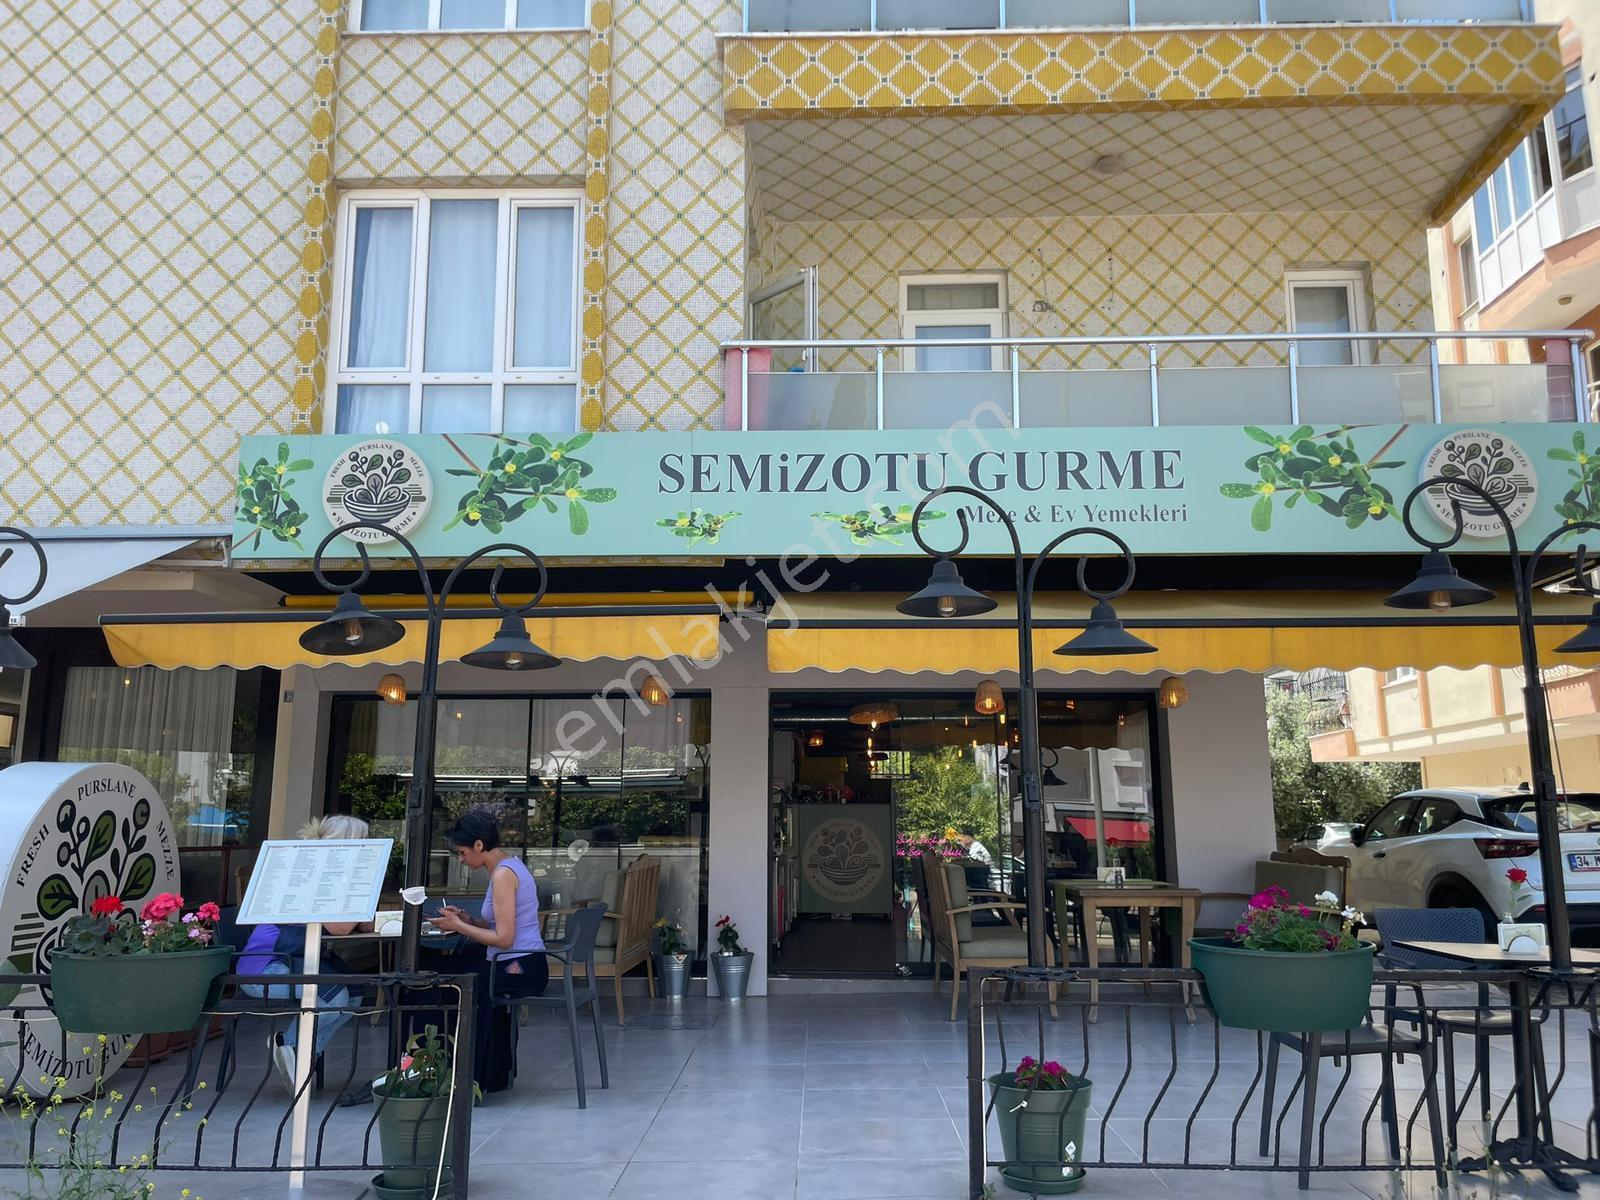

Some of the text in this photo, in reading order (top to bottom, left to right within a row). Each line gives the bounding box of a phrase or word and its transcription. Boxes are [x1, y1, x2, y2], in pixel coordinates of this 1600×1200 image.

[331, 443, 424, 478] FRESH PURSLANE MEZZE
[1427, 431, 1528, 469] FRESH PURSLANE MEZZE
[969, 449, 1185, 492] GURME
[382, 515, 414, 538] GRME
[965, 504, 1188, 523] Mee & Ev Yemekleri
[16, 823, 51, 888] FRESH
[76, 778, 137, 801] PURSLANE
[155, 820, 174, 881] MEZZE
[1576, 855, 1589, 867] 34
